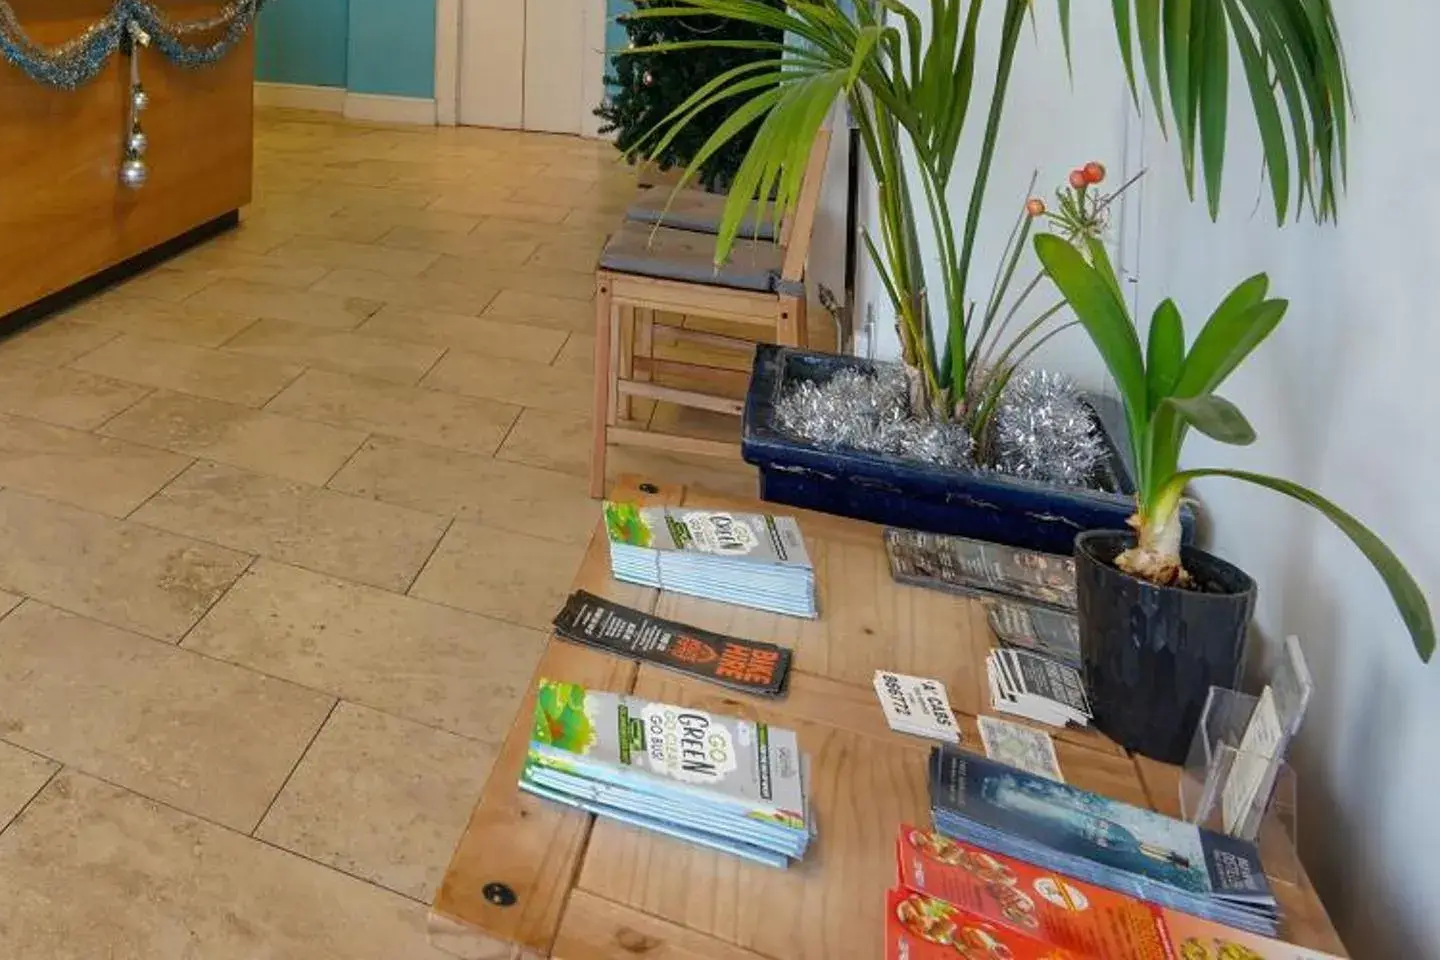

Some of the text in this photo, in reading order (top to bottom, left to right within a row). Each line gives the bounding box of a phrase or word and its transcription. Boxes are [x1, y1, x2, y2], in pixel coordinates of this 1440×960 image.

[650, 715, 664, 735] GO
[927, 697, 952, 726] CABS
[677, 714, 718, 777] GREEN
[709, 734, 727, 763] GO
